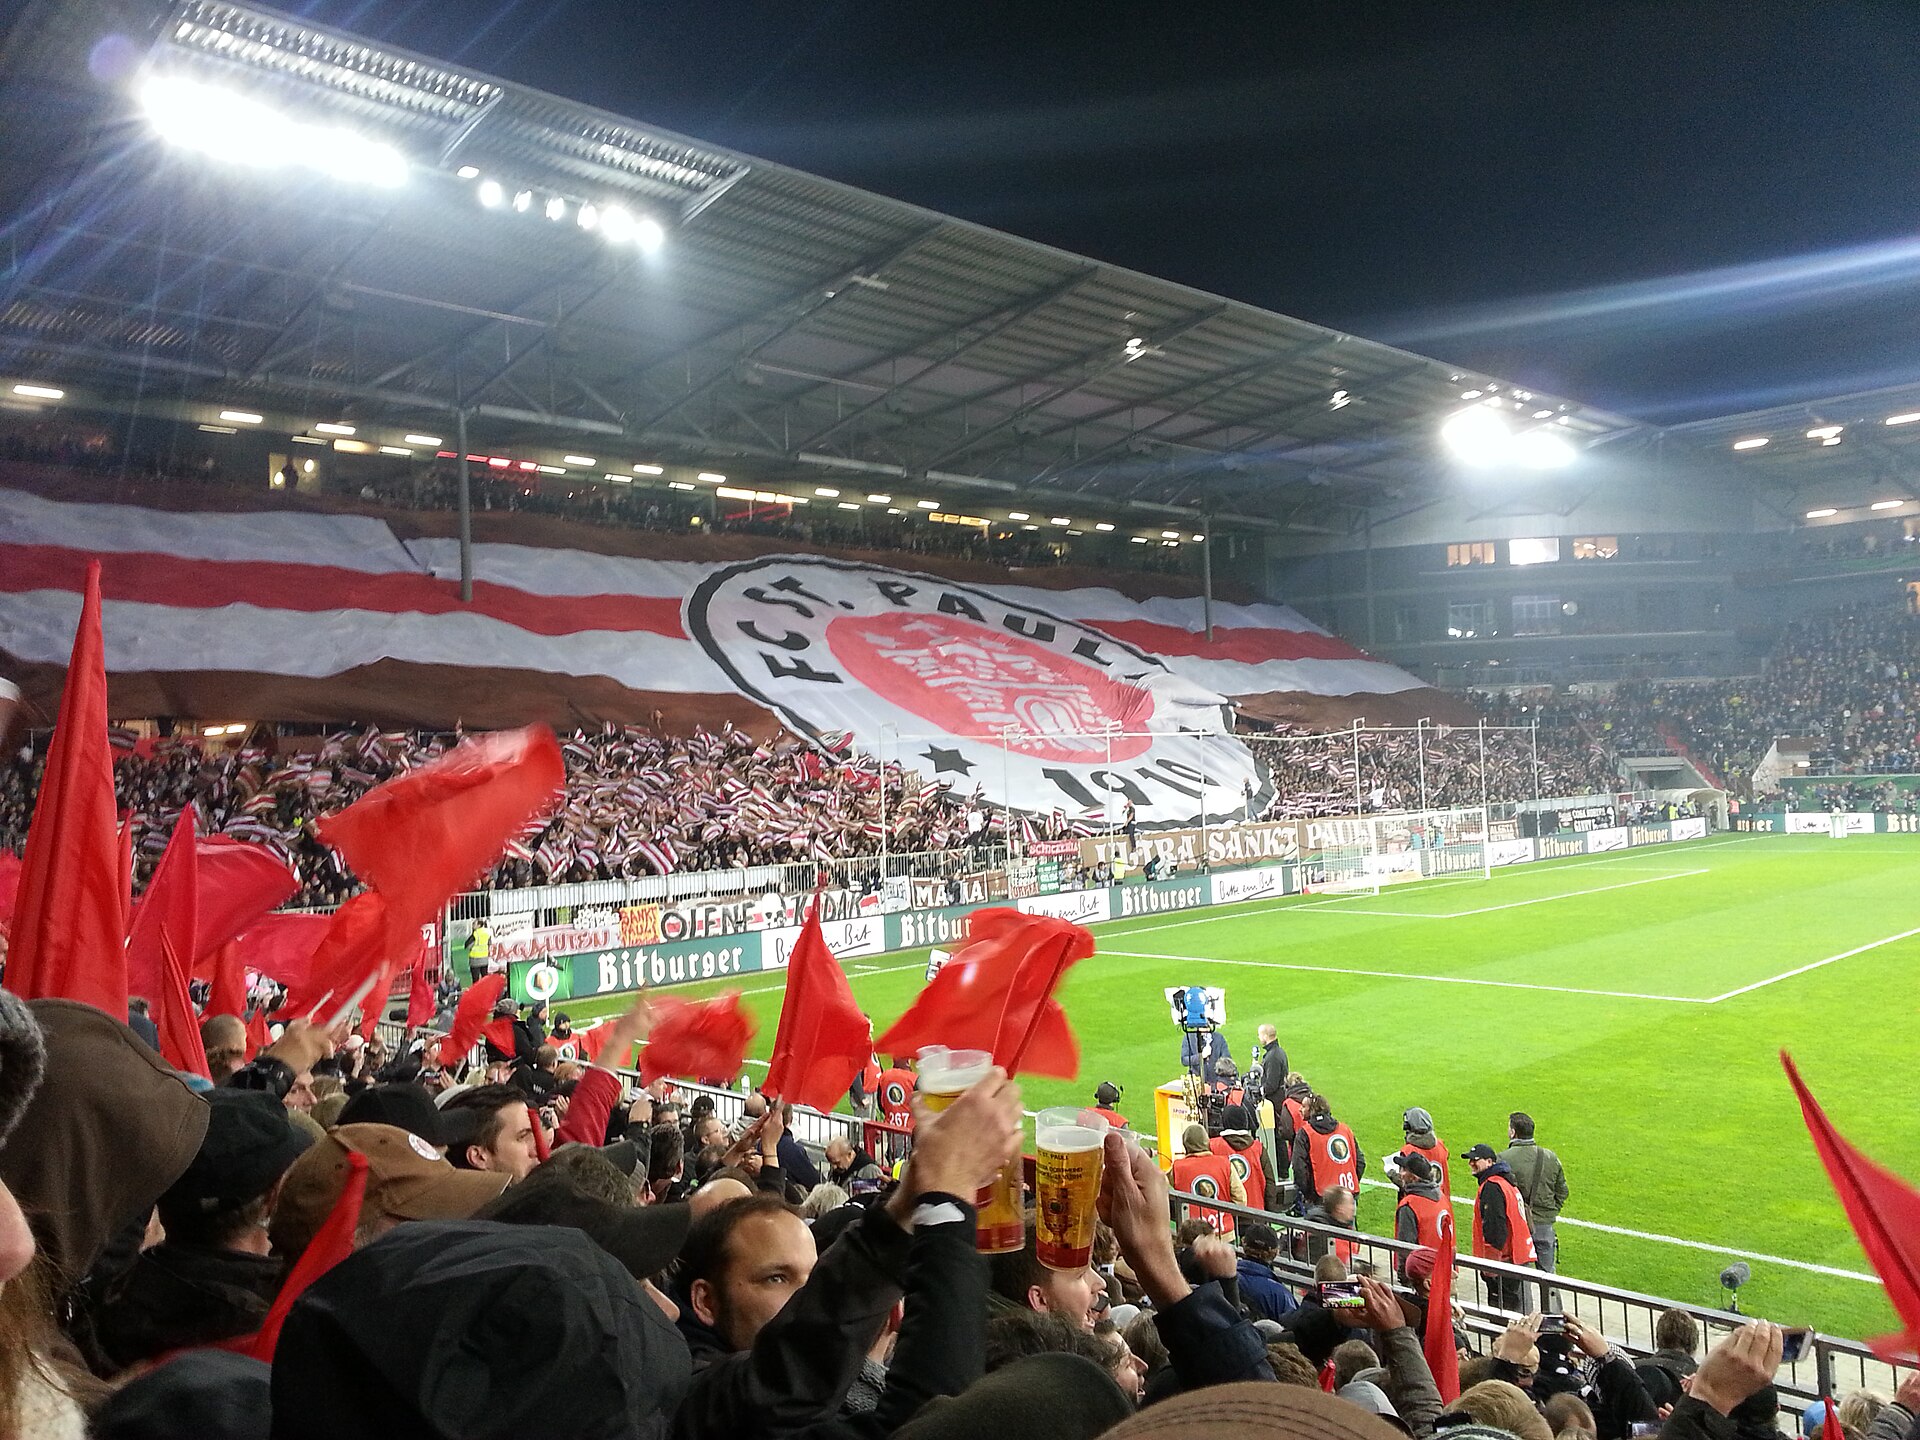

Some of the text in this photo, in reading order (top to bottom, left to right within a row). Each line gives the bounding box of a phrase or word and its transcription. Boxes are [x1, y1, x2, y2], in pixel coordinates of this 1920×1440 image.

[742, 576, 856, 619] ST.
[737, 619, 844, 684] FC
[1041, 758, 1221, 814] 1910
[1632, 827, 1669, 845] Bitburger
[1886, 813, 1920, 833] Bit
[1539, 837, 1584, 859] Bitburger
[1120, 886, 1202, 917] Bitburger
[900, 911, 973, 948] Bitbur
[597, 945, 743, 993] Bitburger
[889, 1111, 909, 1127] 267
[1338, 1172, 1355, 1191] 08
